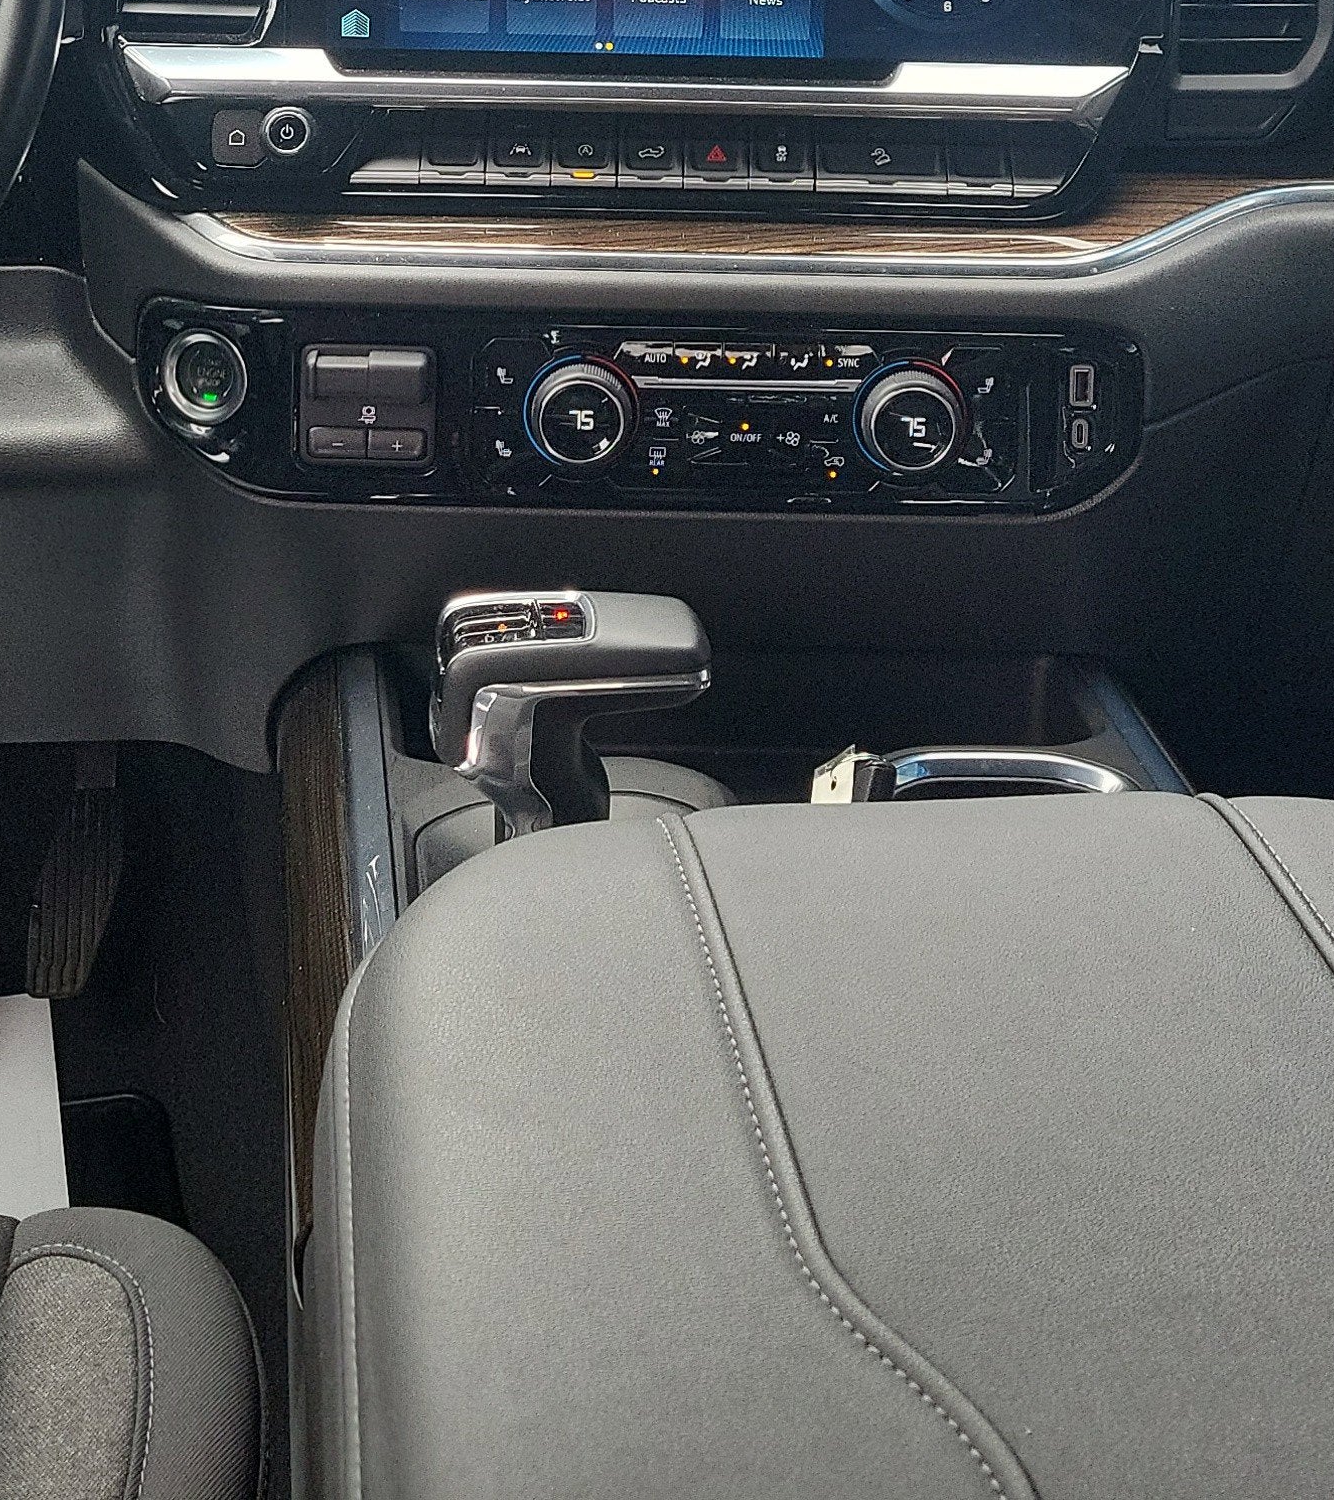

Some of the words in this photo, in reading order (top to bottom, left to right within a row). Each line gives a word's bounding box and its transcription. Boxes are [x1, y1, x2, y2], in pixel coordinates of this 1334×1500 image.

[943, 1, 952, 12] 6
[644, 353, 667, 363] AUTO
[837, 358, 860, 368] SYNC
[569, 410, 594, 431] 75
[656, 420, 670, 428] MAX
[823, 414, 839, 424] A/C
[901, 417, 927, 438] 75
[730, 433, 762, 443] ON/OFF
